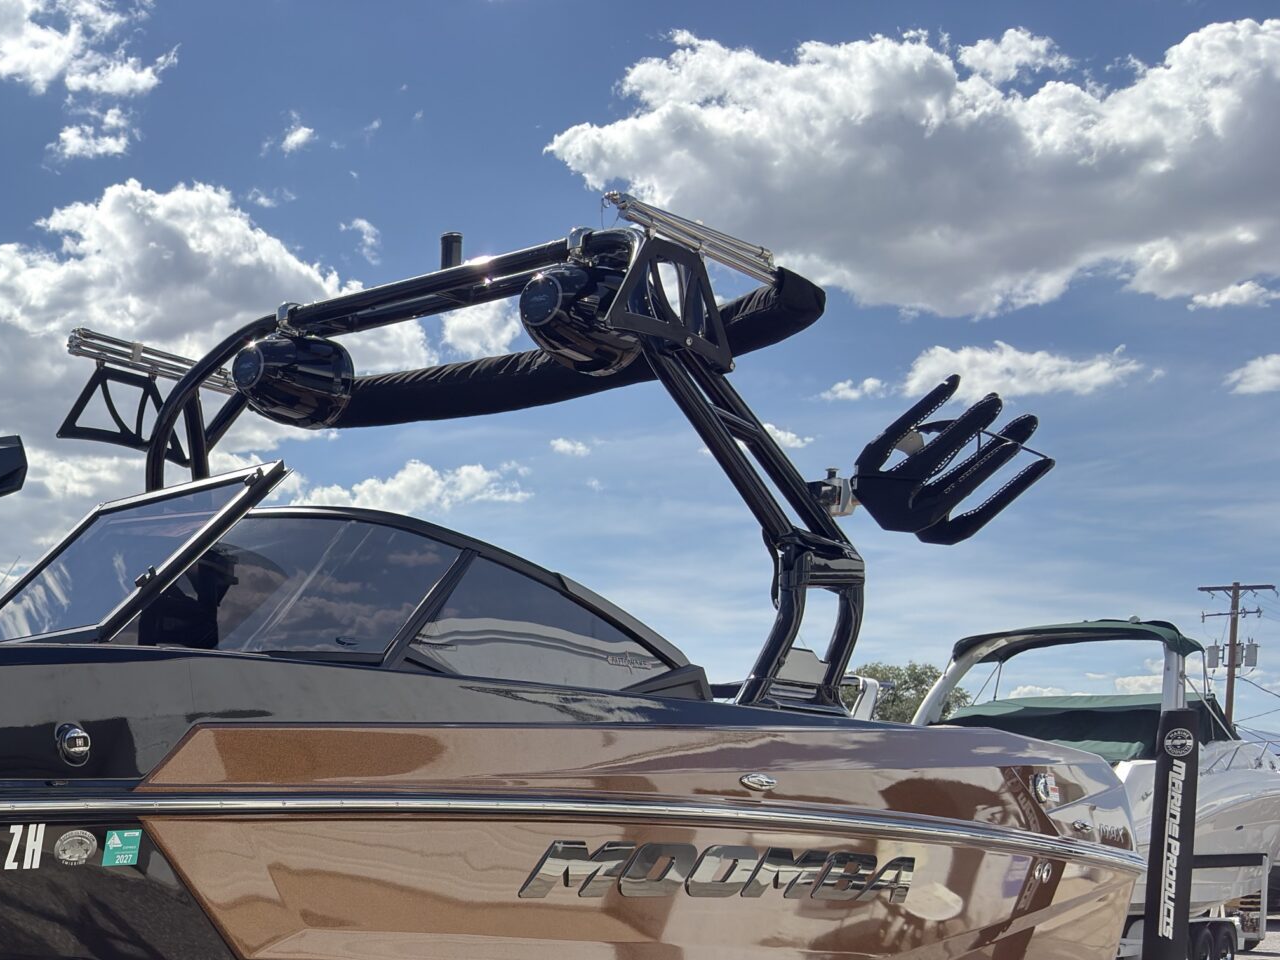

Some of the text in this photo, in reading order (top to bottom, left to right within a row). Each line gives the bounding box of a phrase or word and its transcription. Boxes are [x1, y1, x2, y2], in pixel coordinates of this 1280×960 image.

[1168, 758, 1186, 838] MARINE
[3, 823, 46, 871] ZH
[115, 854, 133, 864] 2027
[1098, 823, 1124, 843] MAX
[517, 839, 916, 904] MOOMBA
[1161, 837, 1180, 941] PRODUCTS
